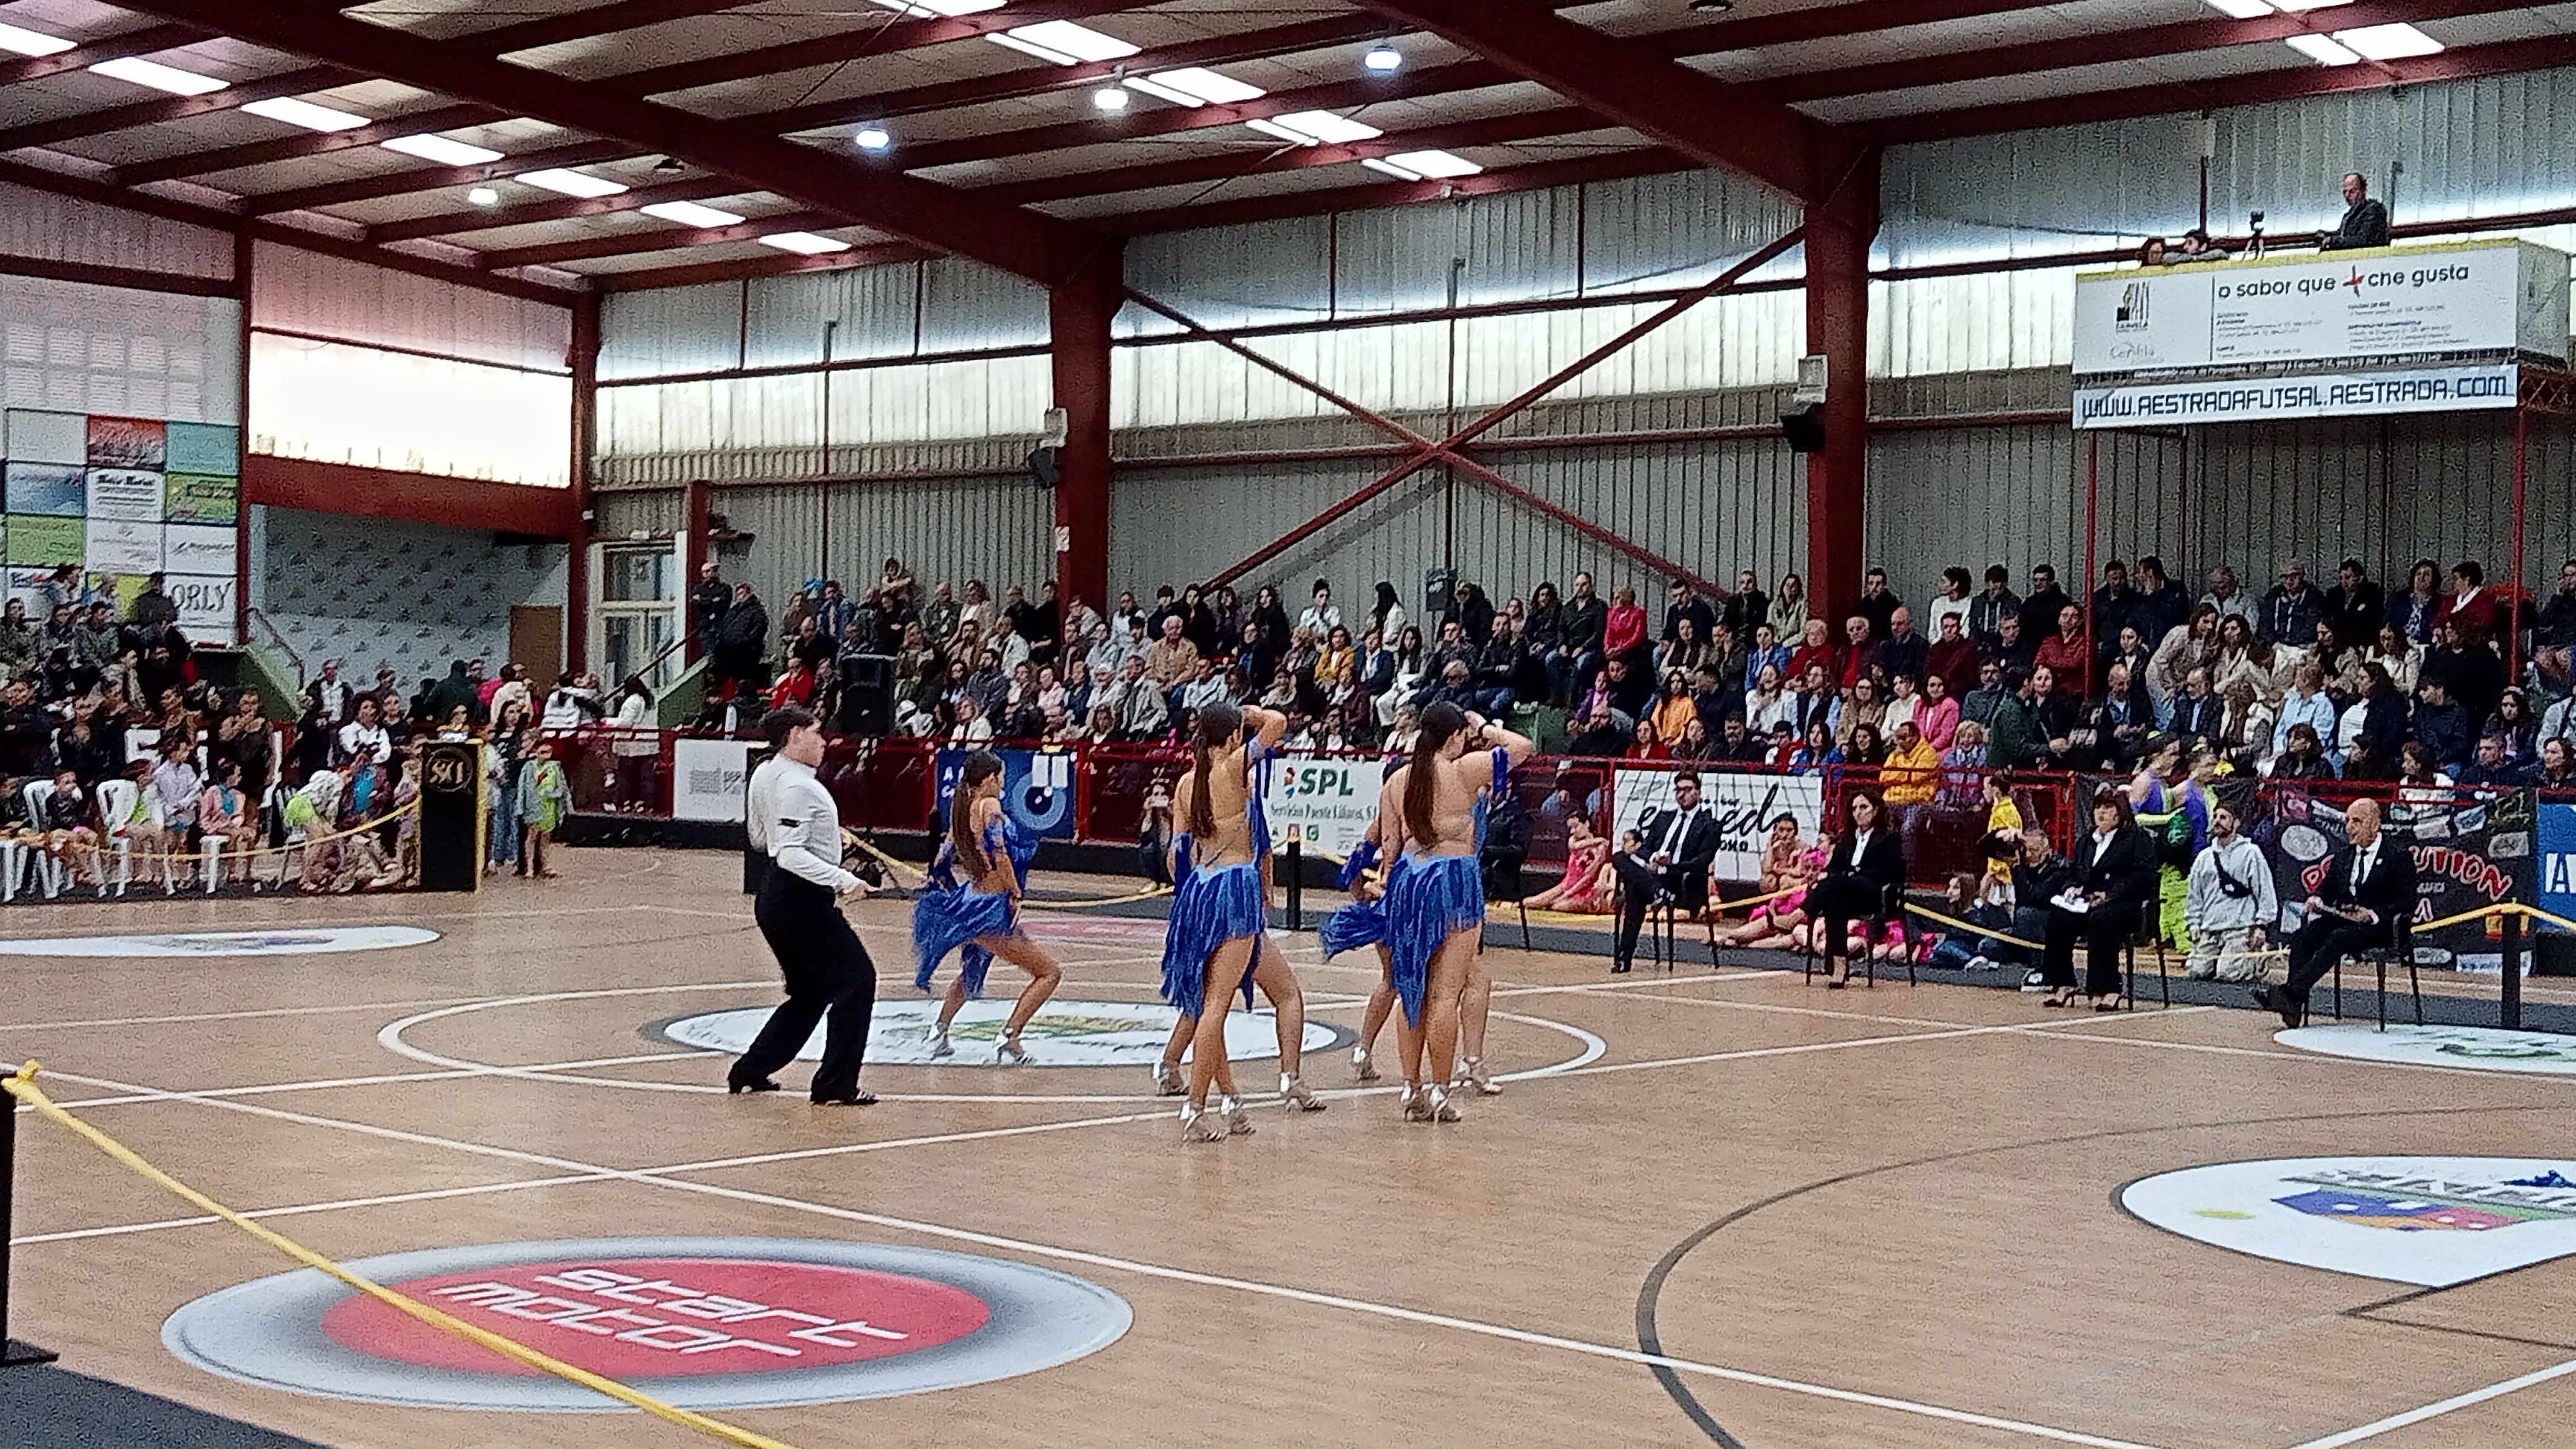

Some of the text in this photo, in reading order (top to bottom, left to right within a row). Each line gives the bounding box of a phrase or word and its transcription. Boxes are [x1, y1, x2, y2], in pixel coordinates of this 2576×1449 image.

[2218, 284, 2230, 298] o
[2236, 278, 2291, 297] sabor
[2297, 277, 2336, 296] que
[2411, 263, 2469, 287] gusta
[1297, 768, 1354, 797] SPL
